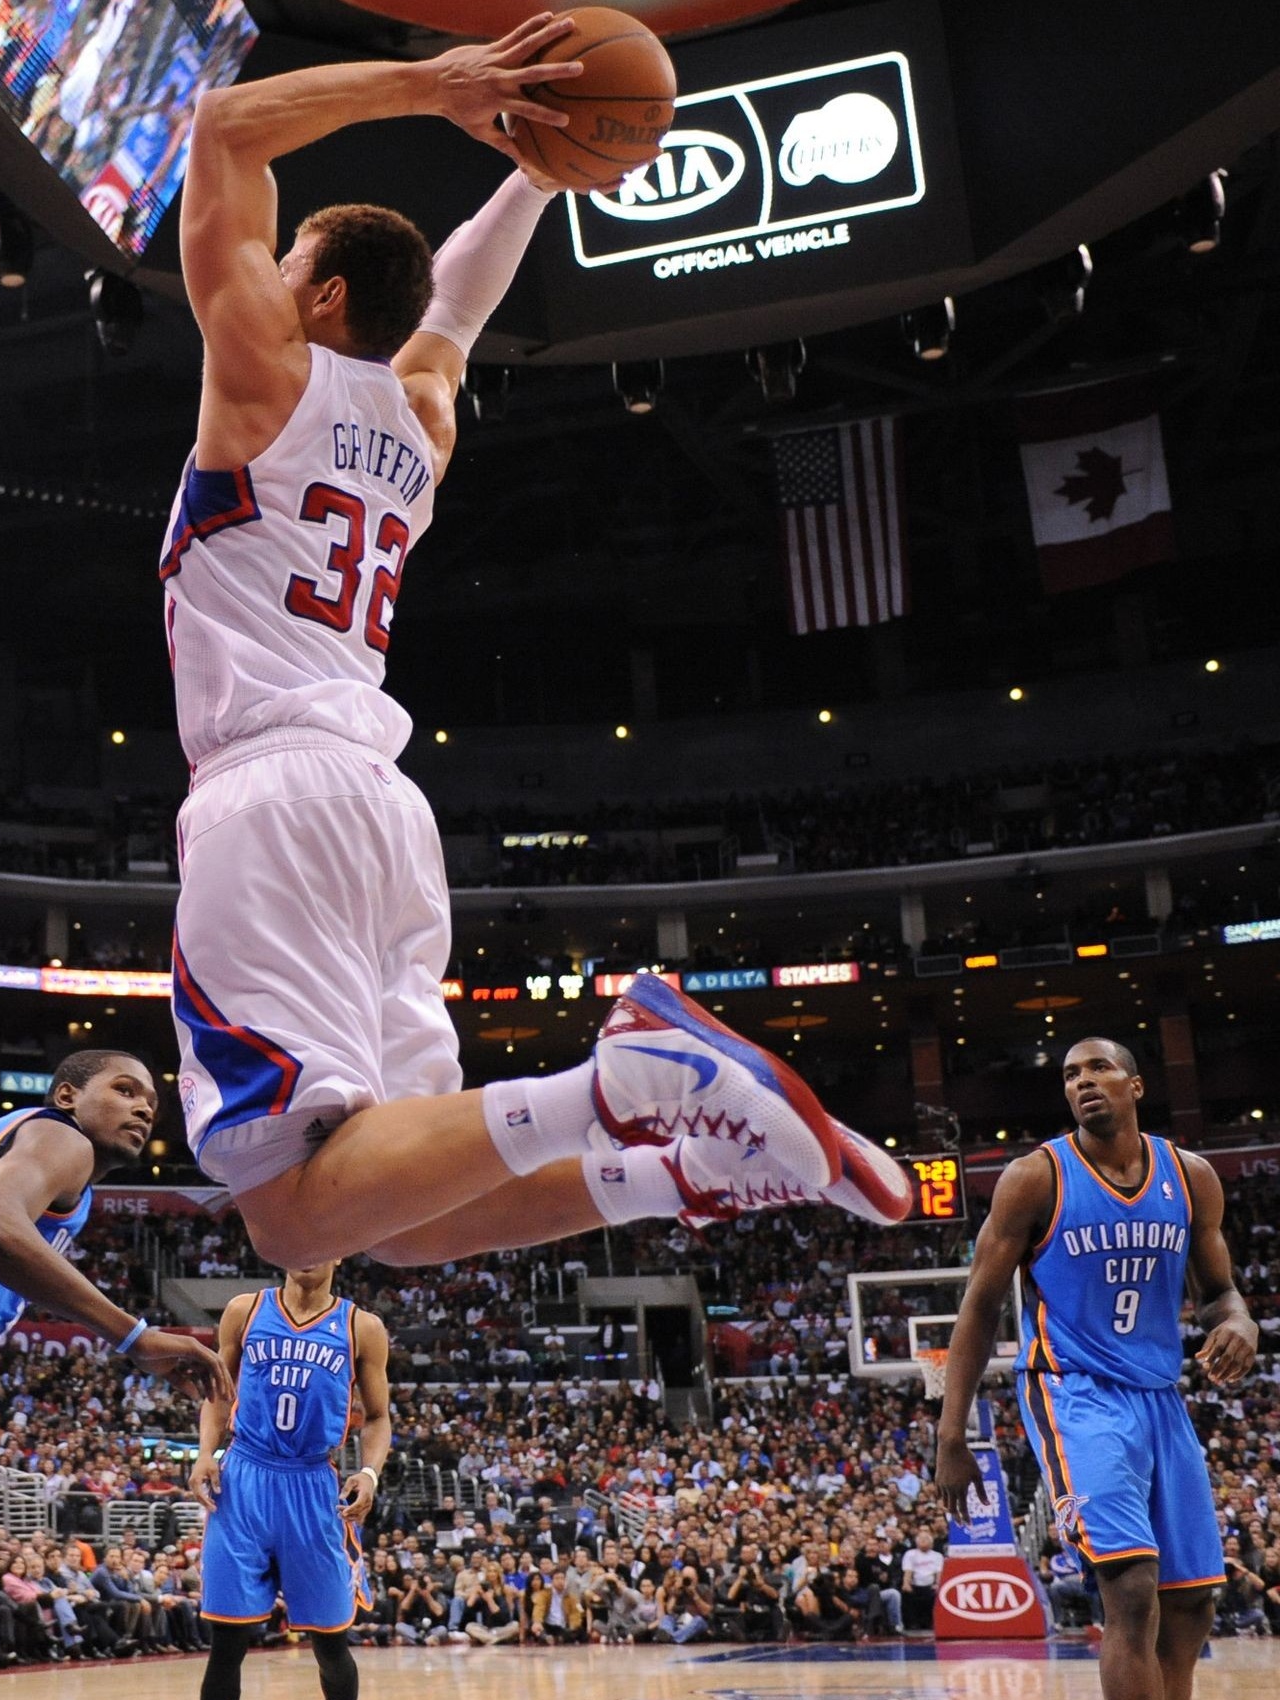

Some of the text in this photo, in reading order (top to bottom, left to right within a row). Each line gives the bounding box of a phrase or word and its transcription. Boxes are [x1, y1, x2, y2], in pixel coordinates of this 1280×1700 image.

[619, 146, 724, 206] KIA
[653, 223, 851, 279] OFFICIAL VEHICLE
[333, 423, 429, 506] GRIFFIN
[284, 481, 410, 655] 32
[705, 970, 767, 988] DELTA
[779, 963, 852, 986] STAPLES
[913, 1159, 957, 1182] 7:23
[920, 1181, 954, 1216] 12
[1062, 1221, 1187, 1257] OKLAHOMA
[1104, 1256, 1158, 1284] CITY
[1112, 1289, 1140, 1335] 9
[246, 1337, 346, 1375] OKLAHOMA
[270, 1365, 313, 1390] CITY
[275, 1392, 297, 1432] 0
[955, 1582, 1020, 1610] KIA
